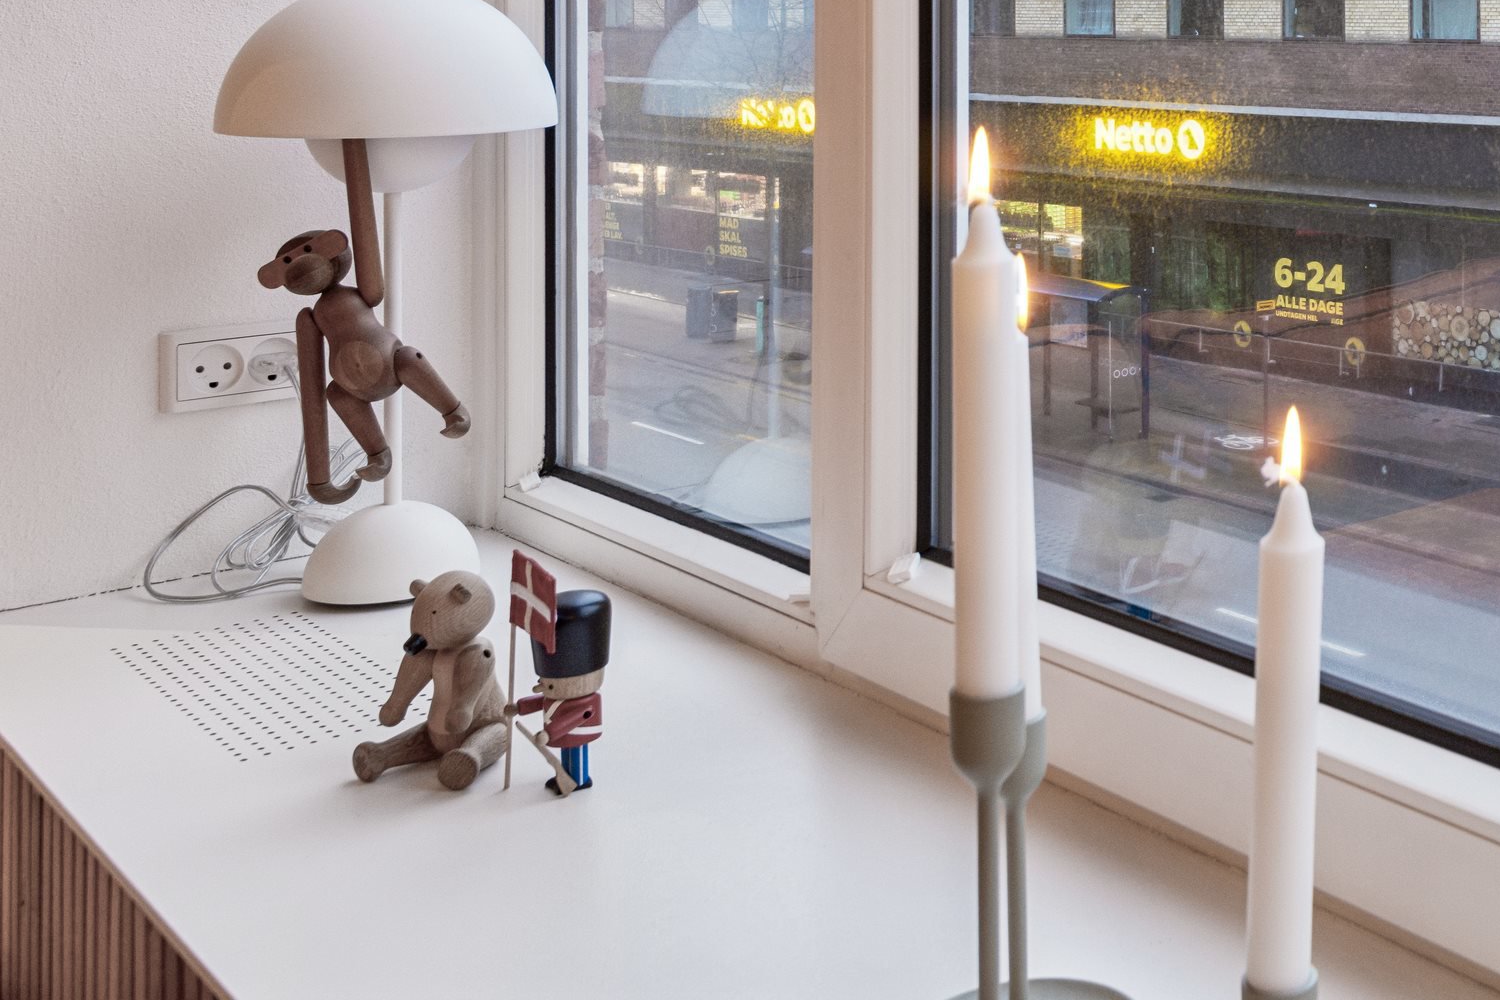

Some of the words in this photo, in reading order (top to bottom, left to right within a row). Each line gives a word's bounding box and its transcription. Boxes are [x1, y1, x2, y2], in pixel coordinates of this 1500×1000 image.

[1095, 117, 1174, 154] Netto
[719, 217, 739, 229] MAD
[719, 230, 742, 243] SKAL
[719, 244, 748, 258] SPISES
[1274, 257, 1345, 295] 6-24
[1275, 295, 1307, 310] ALLE
[1309, 298, 1344, 316] DAGE
[1275, 310, 1307, 321] UNDTAGEN
